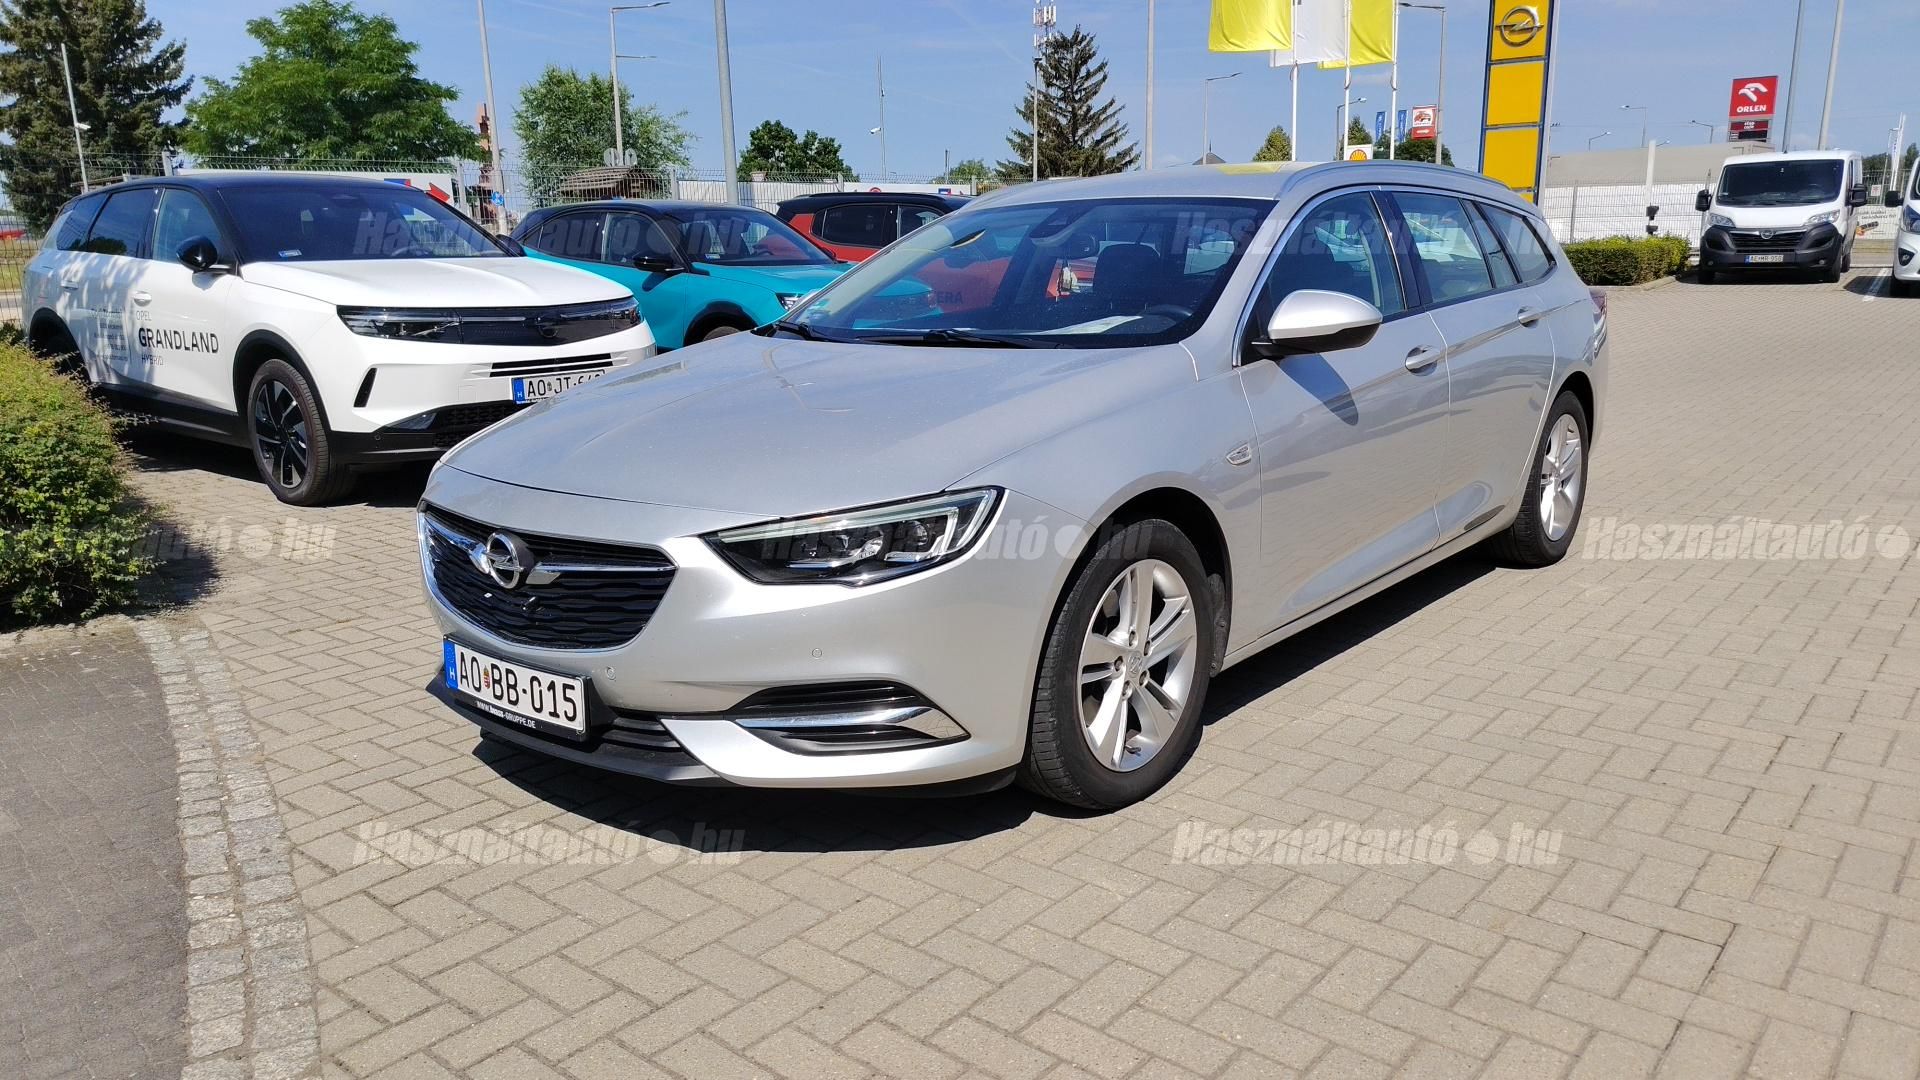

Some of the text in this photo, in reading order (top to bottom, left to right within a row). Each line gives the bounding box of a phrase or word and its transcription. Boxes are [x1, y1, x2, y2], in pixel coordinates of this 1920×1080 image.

[1737, 104, 1767, 113] ORLEN
[136, 310, 152, 321] OPEL
[138, 327, 219, 354] GRANDLAND
[141, 353, 164, 366] HYBRID
[449, 666, 456, 681] H
[490, 662, 578, 722] BB-015
